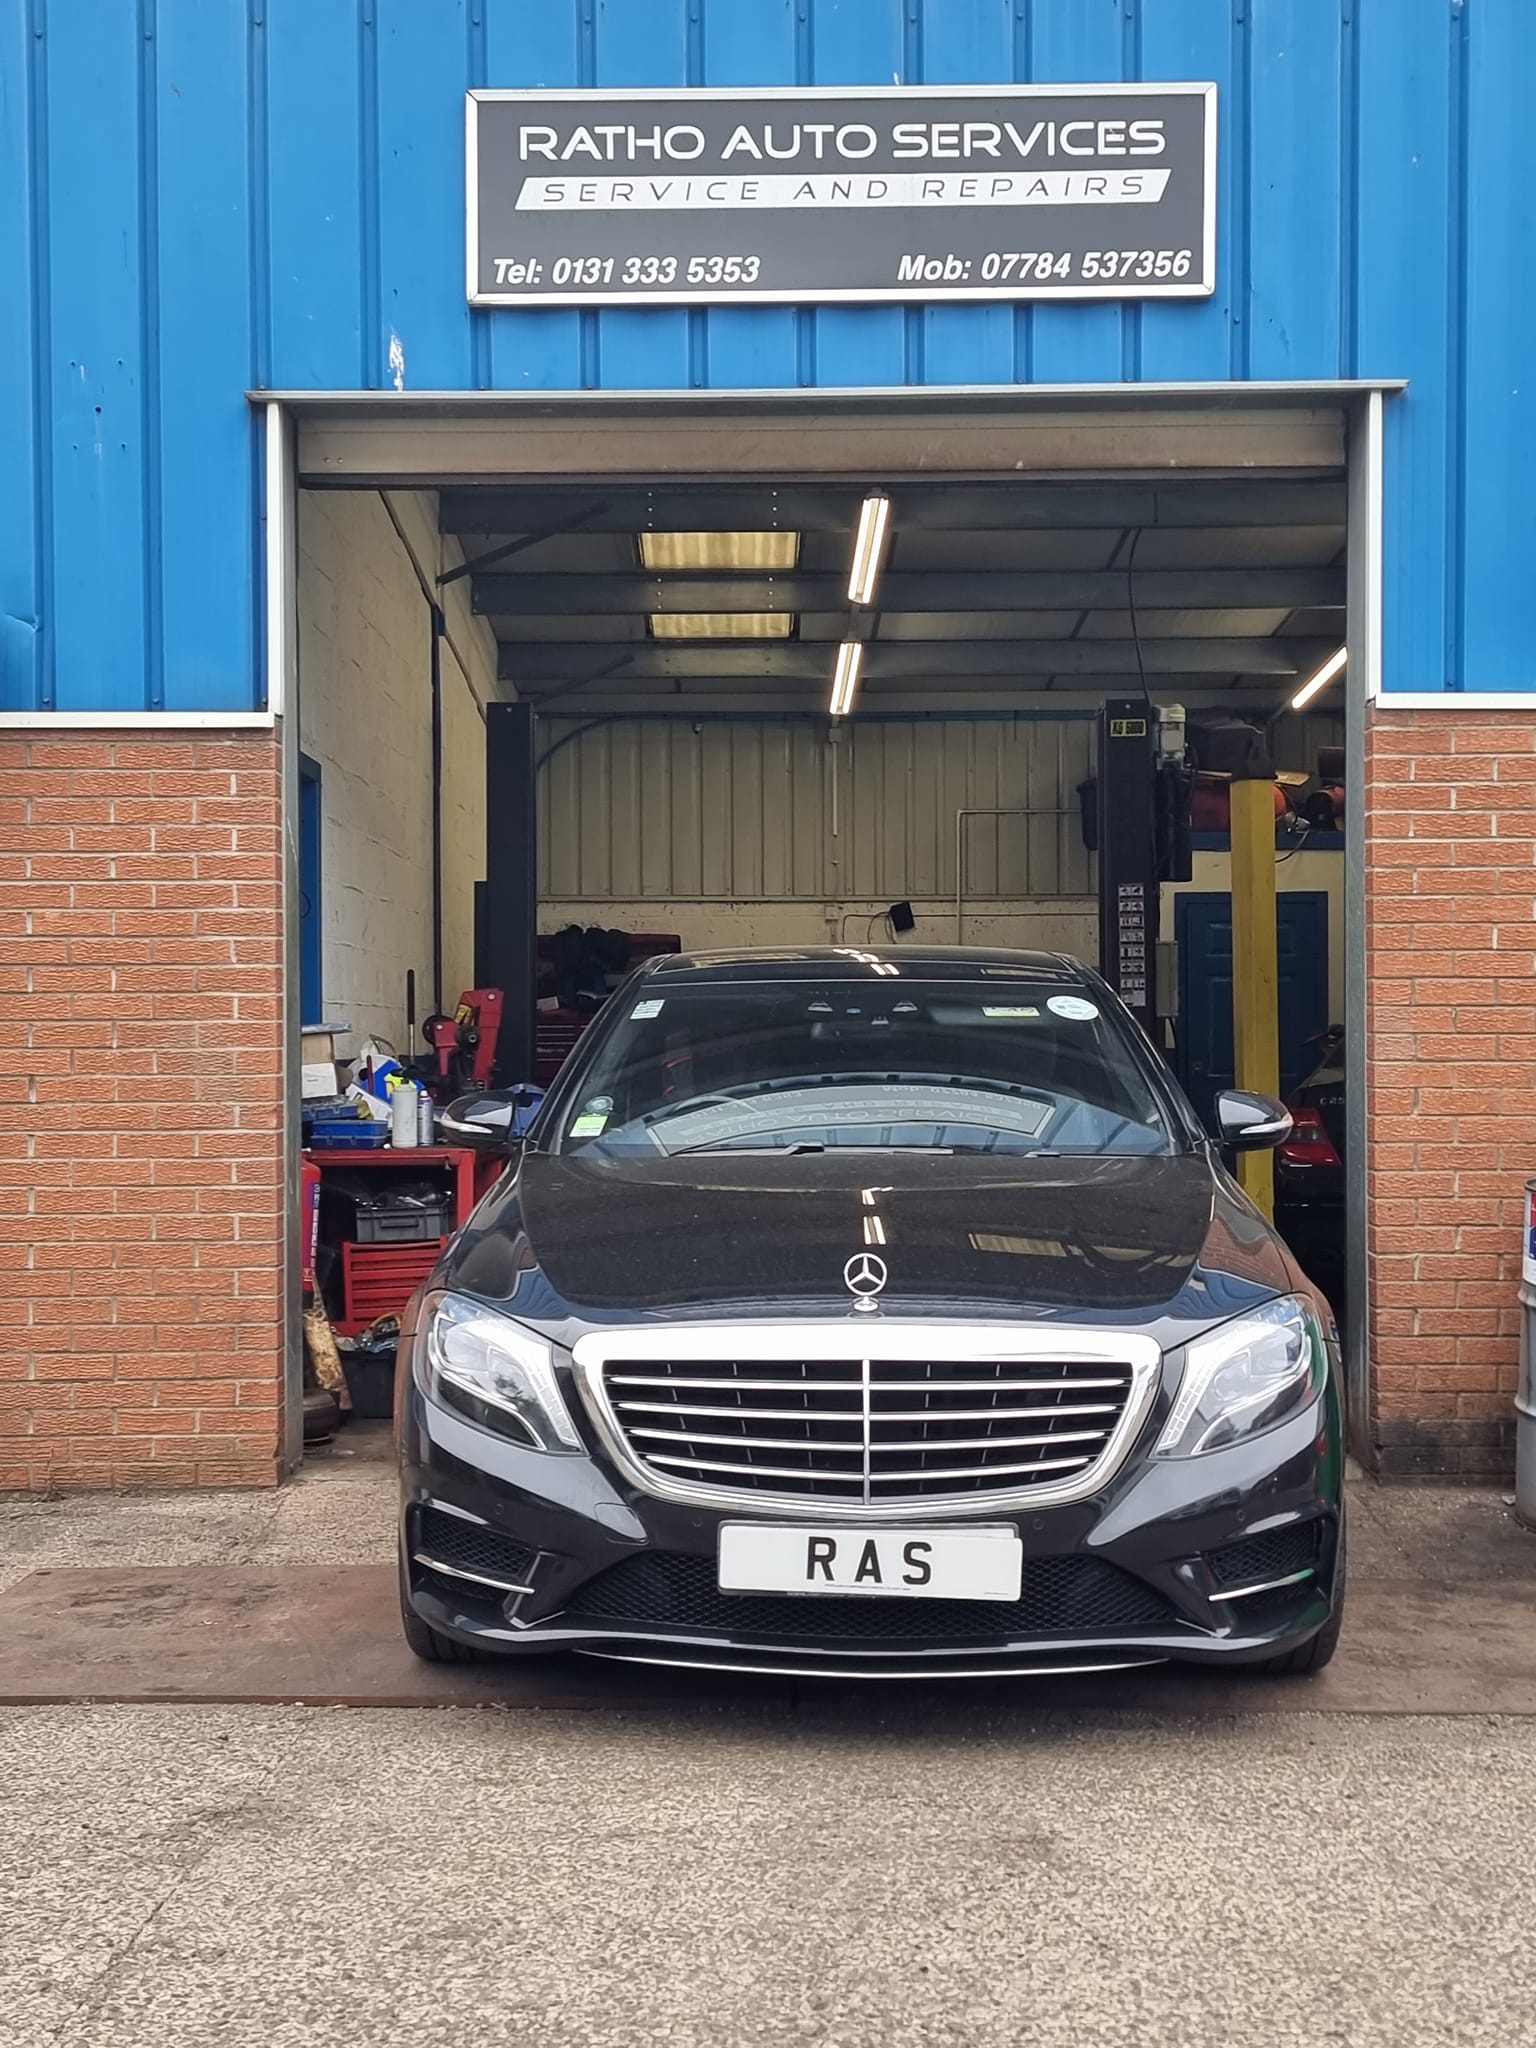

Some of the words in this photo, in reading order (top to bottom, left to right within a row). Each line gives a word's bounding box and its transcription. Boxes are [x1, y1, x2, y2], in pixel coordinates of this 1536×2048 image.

[519, 124, 705, 160] RATHO
[720, 123, 877, 160] AUTO
[892, 120, 1166, 158] SERVICES
[543, 181, 759, 202] SERVICE
[793, 179, 888, 201] AND
[921, 176, 1144, 200] REPAIRS
[493, 257, 543, 284] Tel:
[552, 257, 615, 284] 0131
[621, 257, 678, 284] 333
[686, 255, 761, 284] 5353
[897, 254, 972, 281] Mob:
[981, 252, 1071, 280] 07784
[1081, 250, 1192, 278] 537356
